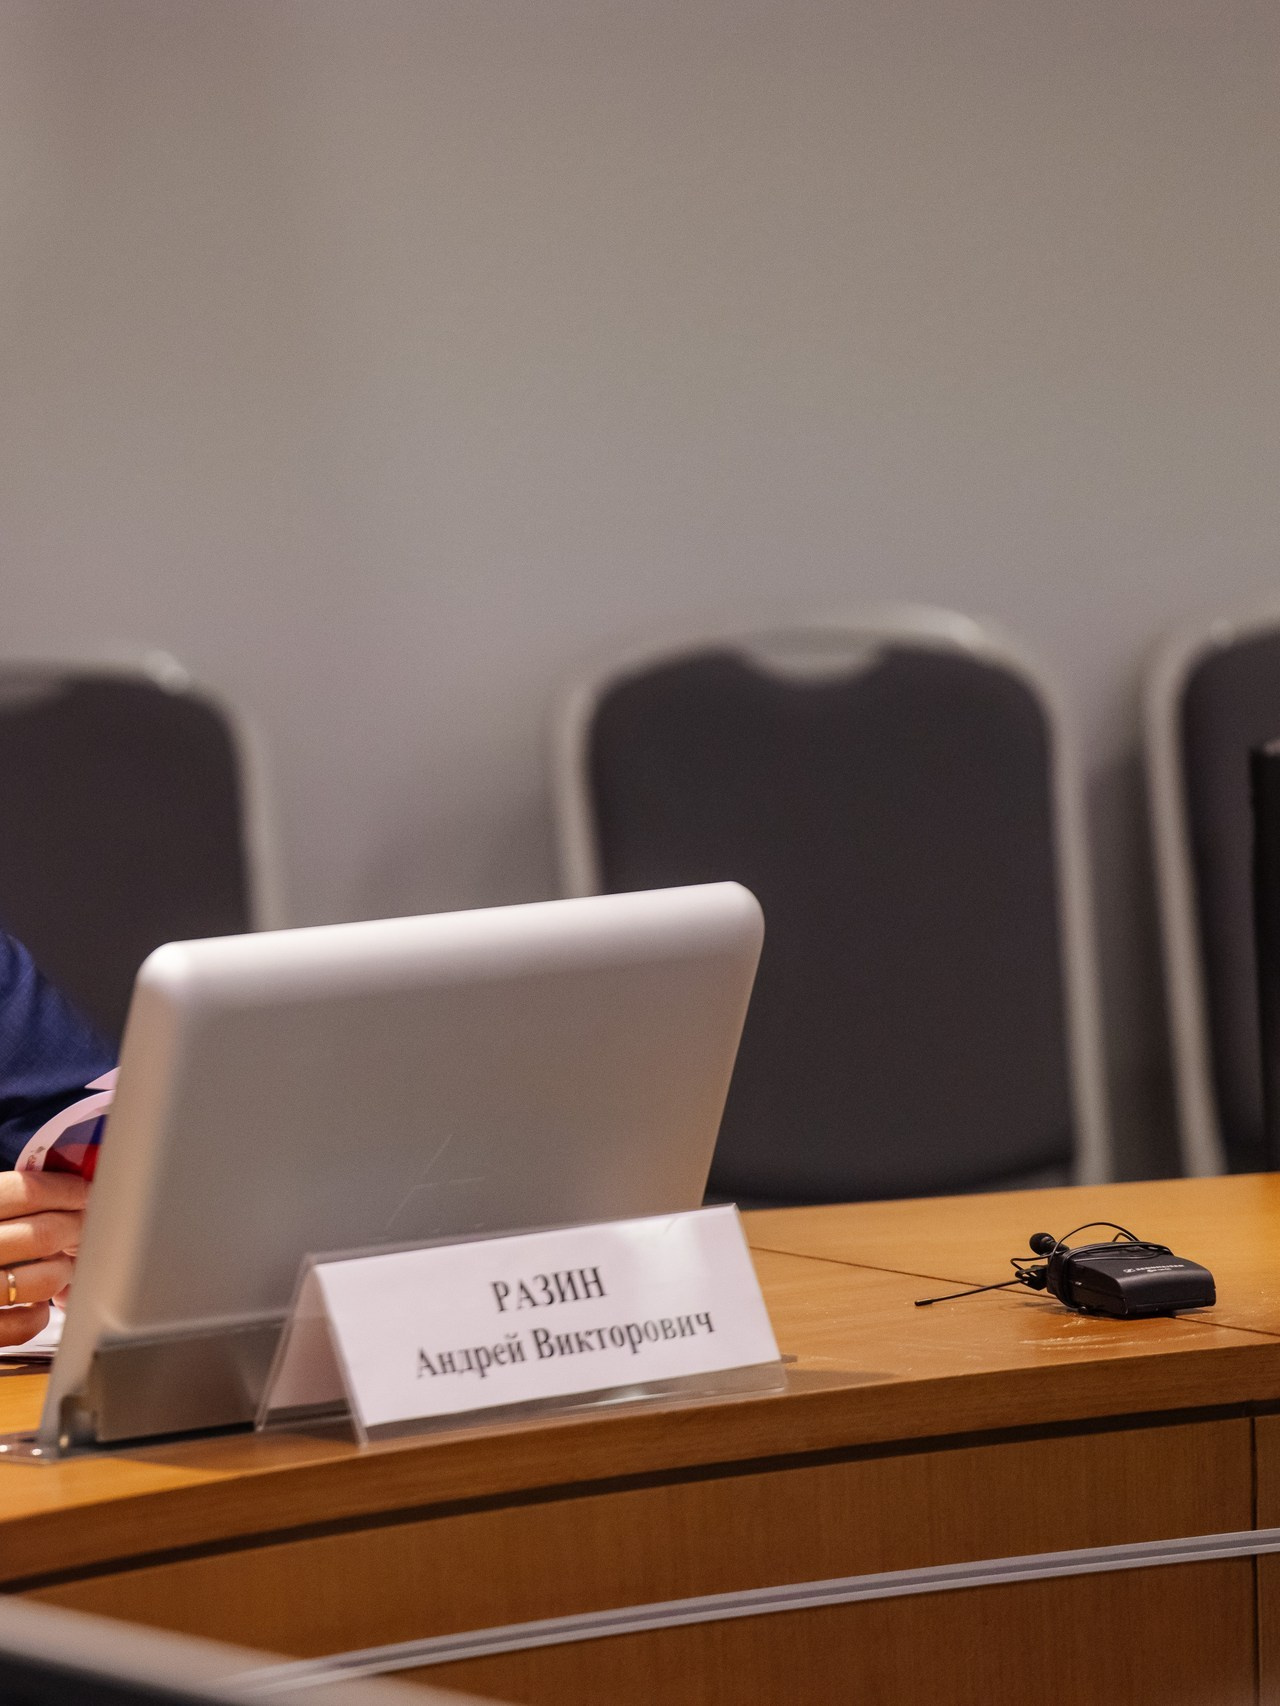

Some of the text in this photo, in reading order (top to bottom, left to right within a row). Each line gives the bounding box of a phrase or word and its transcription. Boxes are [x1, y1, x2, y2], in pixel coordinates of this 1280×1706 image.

[490, 1266, 608, 1313] РАЗИН
[416, 1311, 716, 1379] Андрей Викторович
